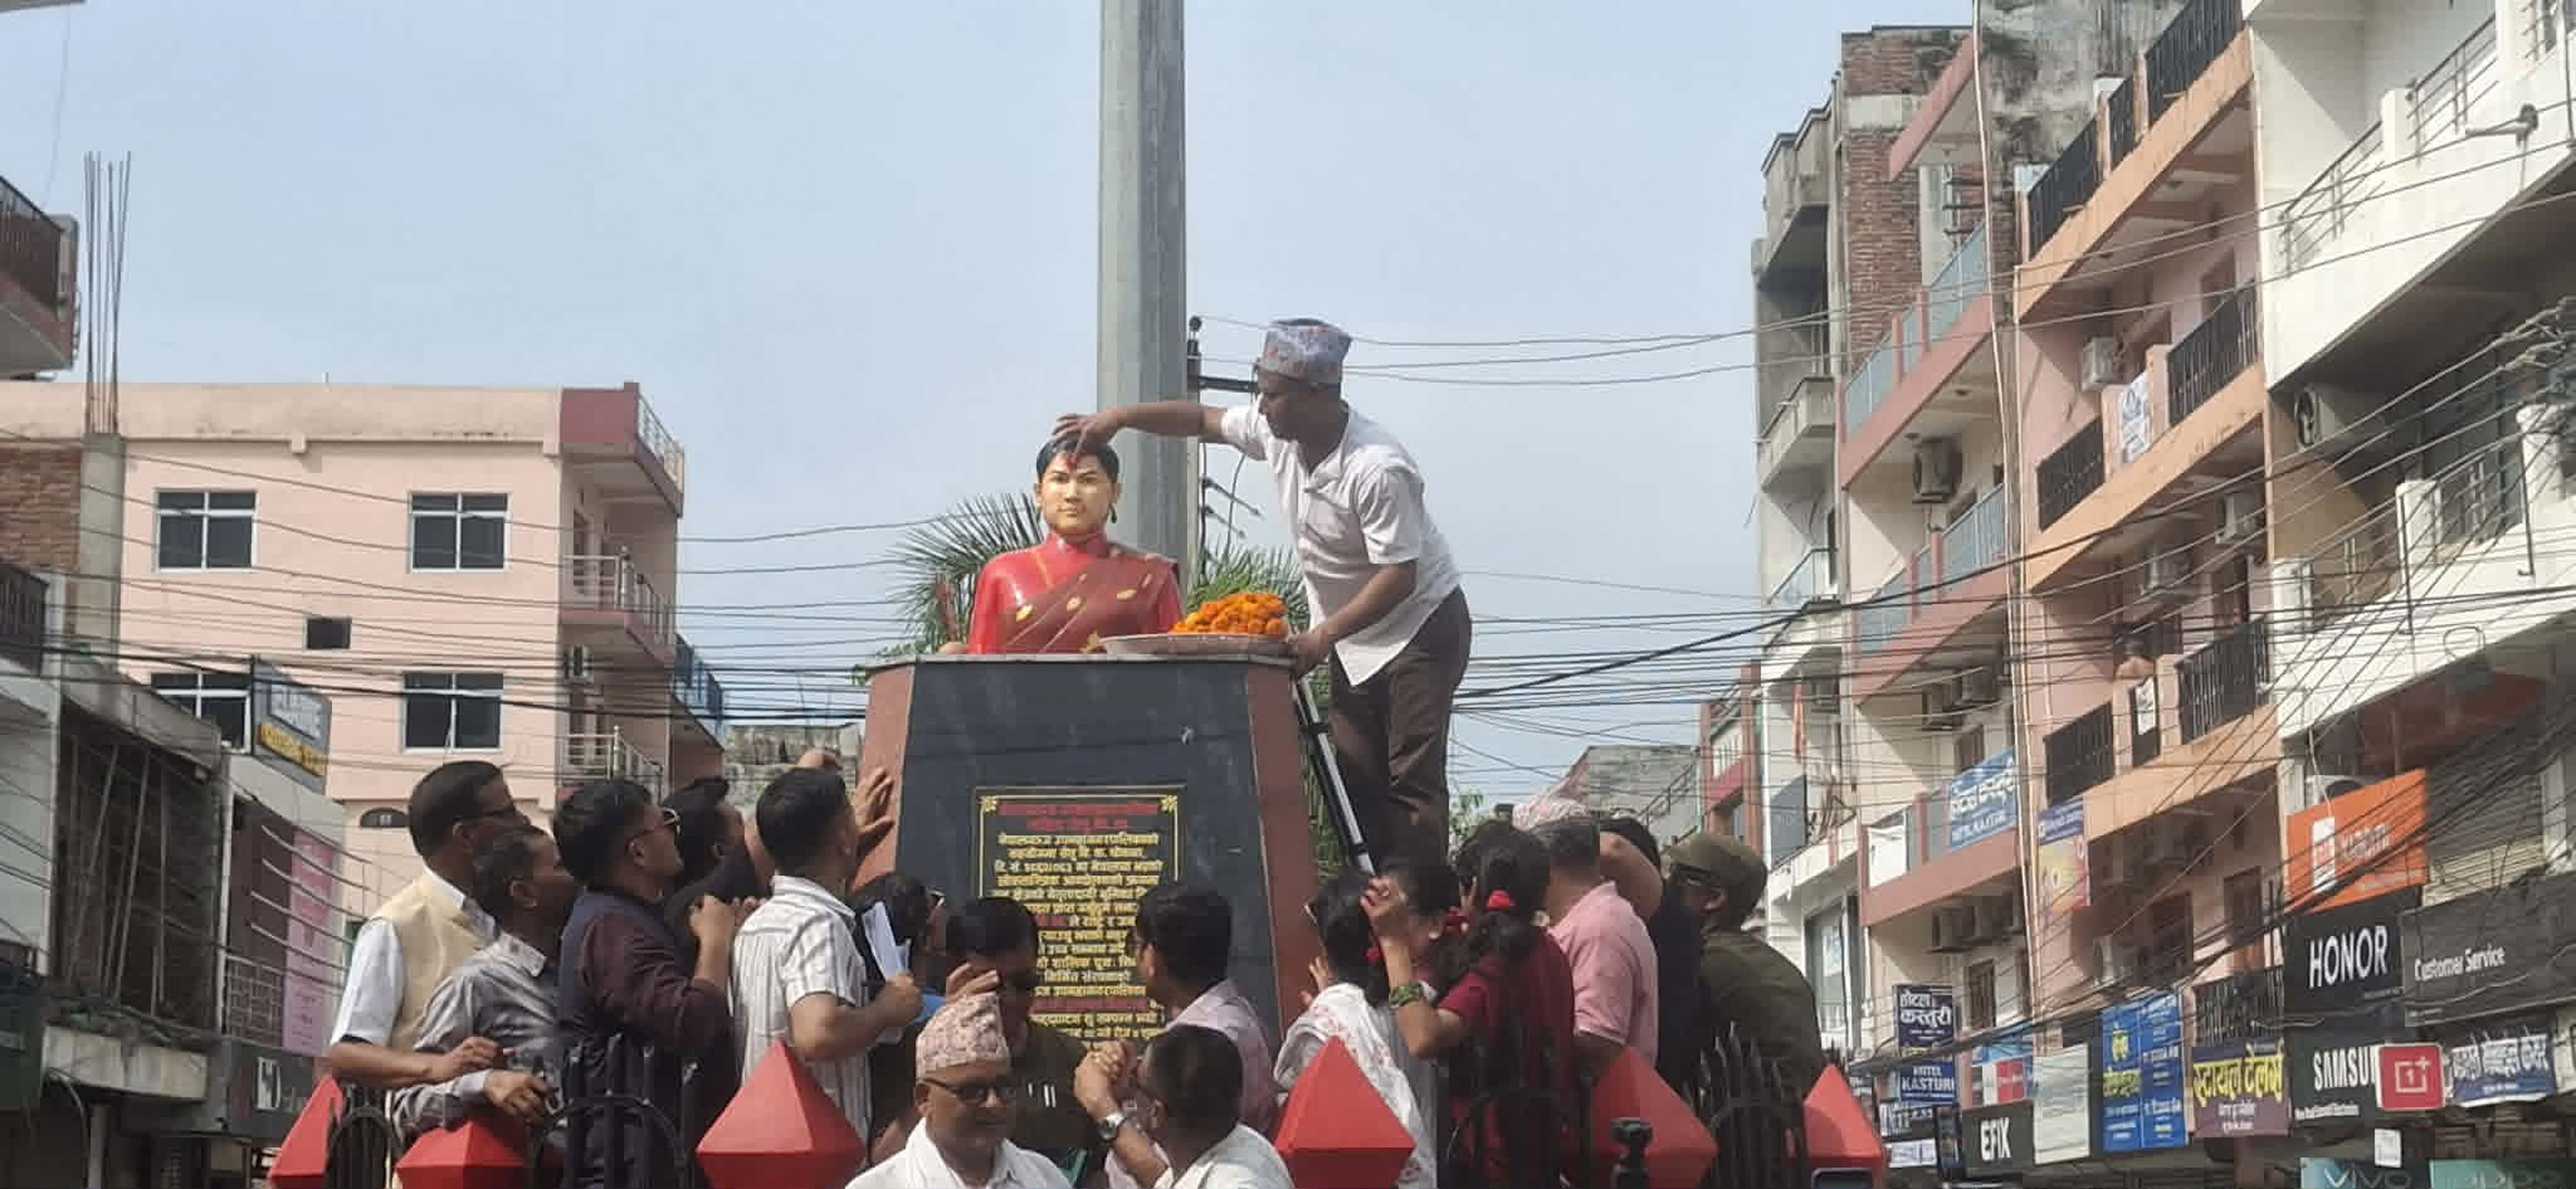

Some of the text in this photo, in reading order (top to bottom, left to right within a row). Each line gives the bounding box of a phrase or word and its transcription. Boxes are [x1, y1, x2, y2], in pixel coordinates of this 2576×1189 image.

[2309, 925, 2388, 990] HONOR
[2464, 943, 2506, 973] Service
[1901, 1005, 1952, 1028] कस्तुरी
[2313, 1046, 2377, 1091] SAMSU
